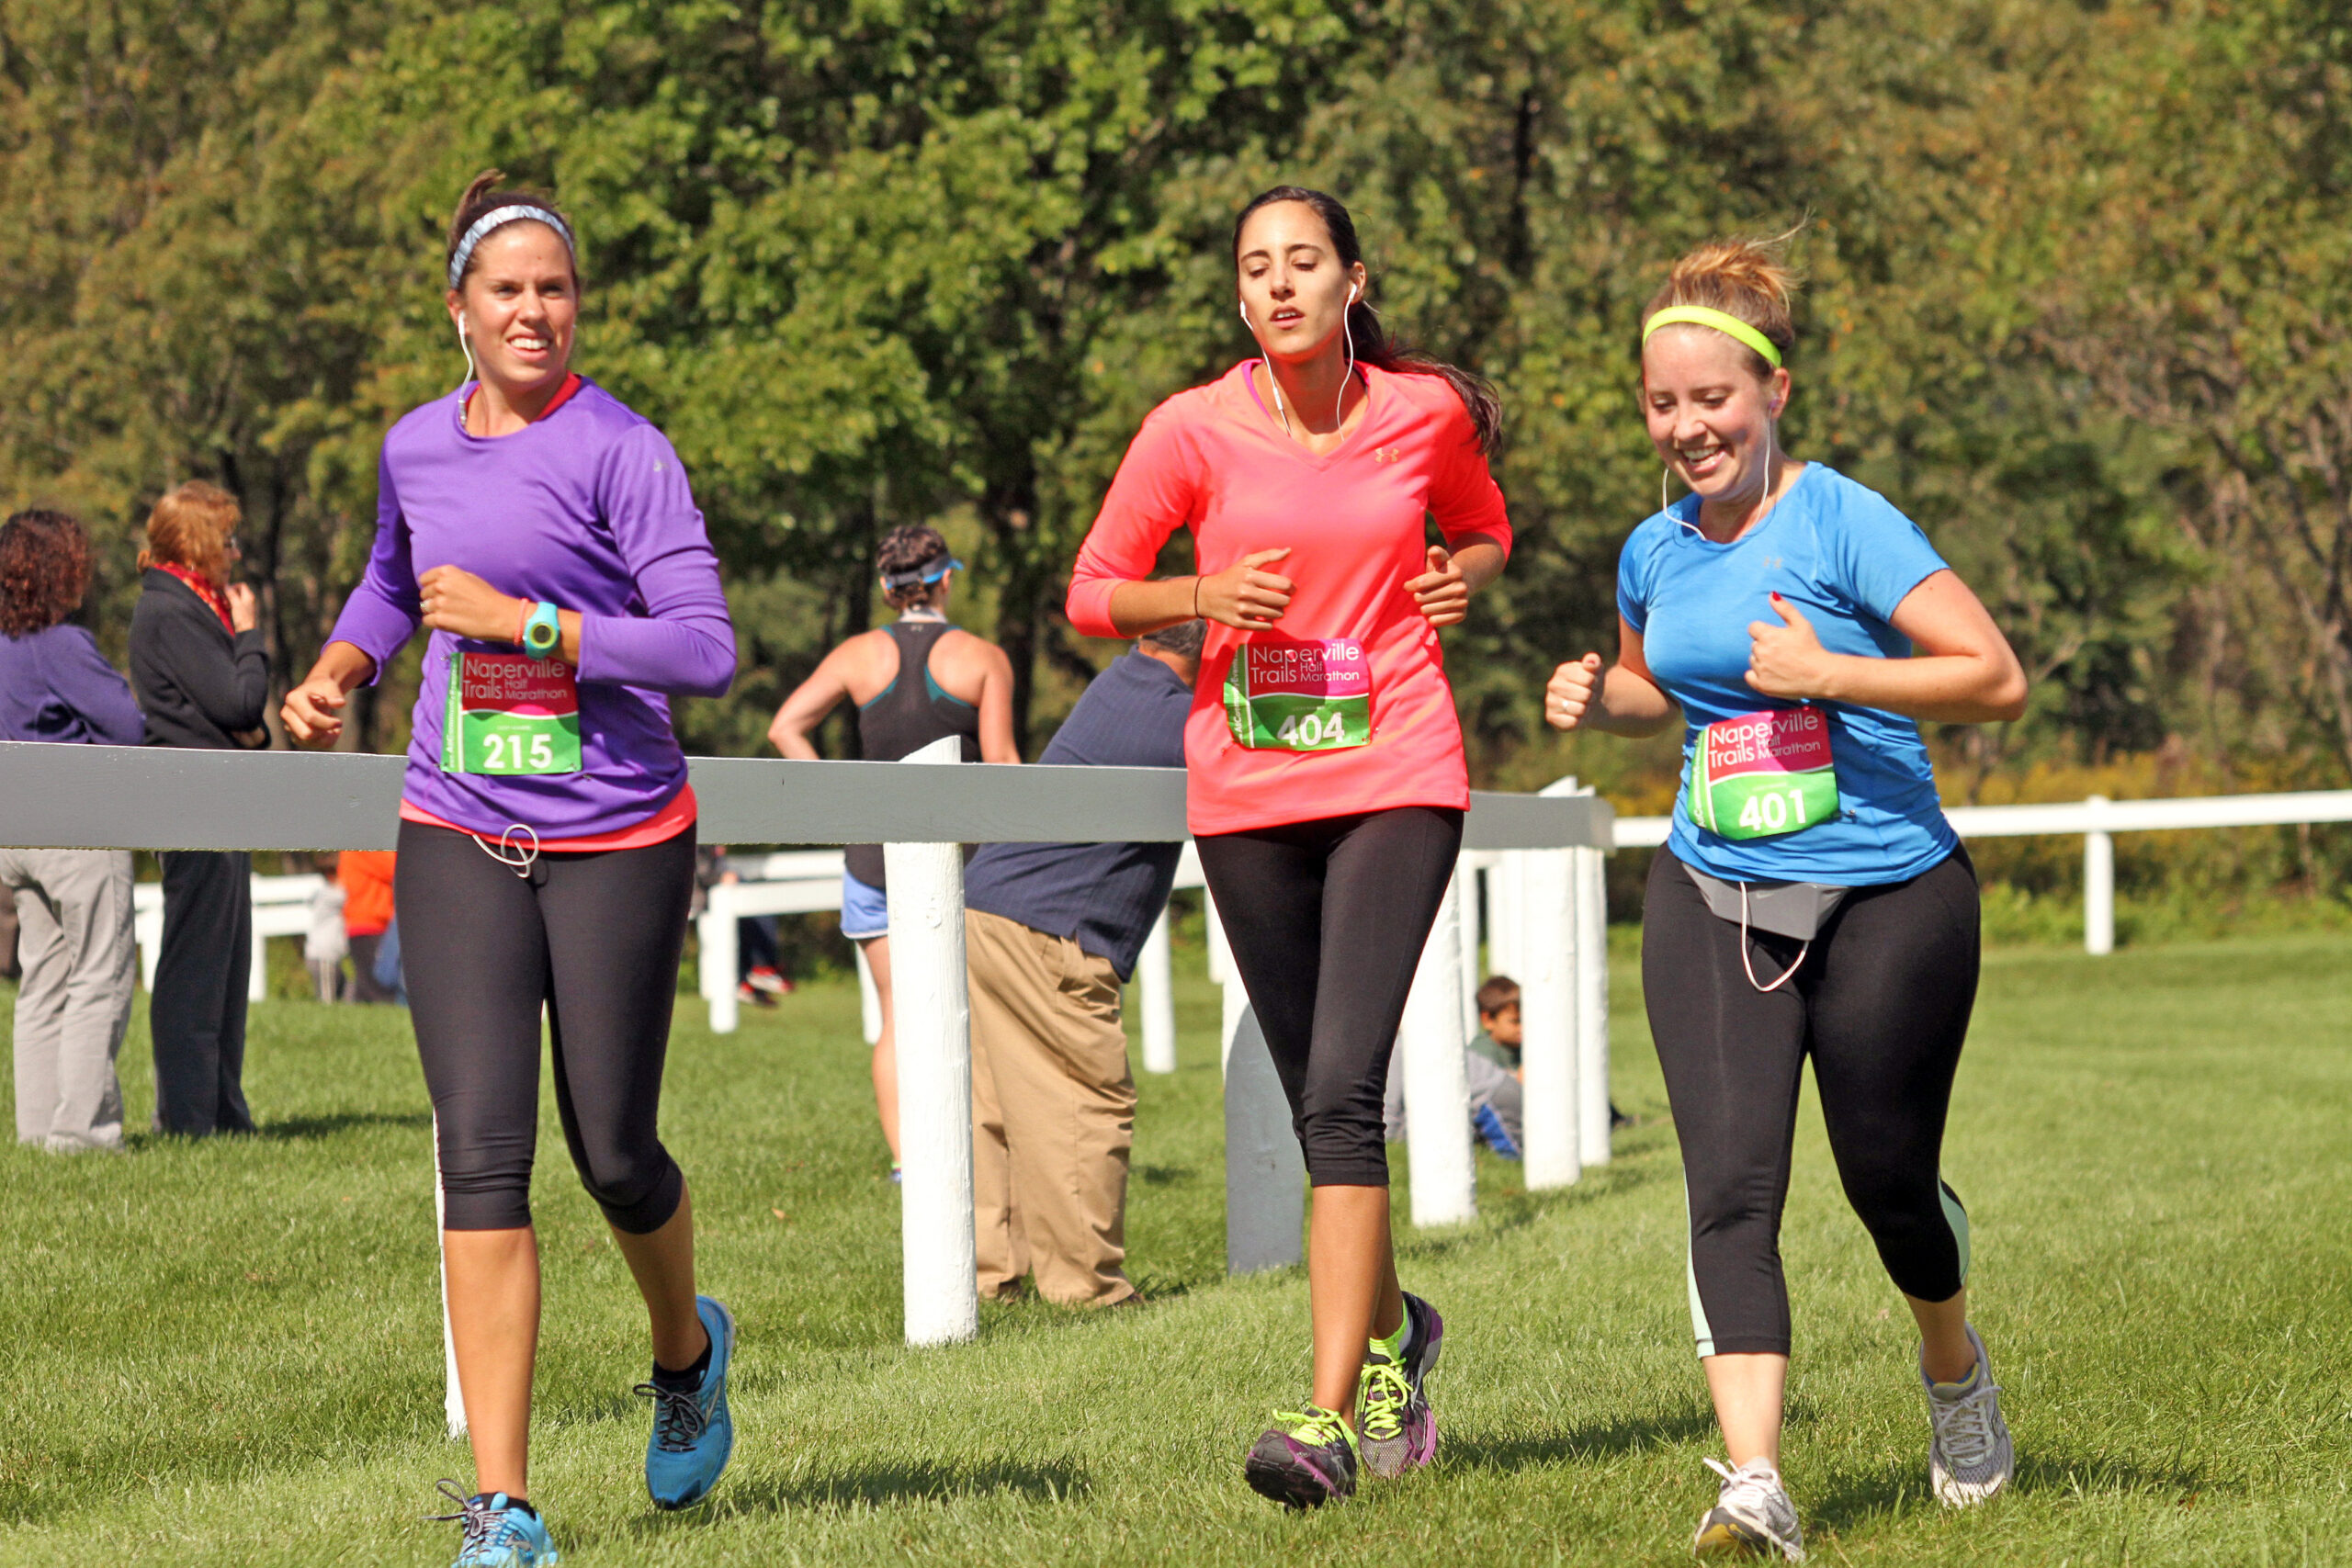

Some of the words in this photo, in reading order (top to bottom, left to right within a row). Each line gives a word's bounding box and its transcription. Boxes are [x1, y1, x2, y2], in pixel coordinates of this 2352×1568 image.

[1253, 643, 1360, 668] Naperville
[466, 658, 565, 685] Naperville
[1250, 665, 1296, 683] Trails
[1300, 661, 1323, 673] Half
[1300, 671, 1360, 682] Marathon
[463, 679, 503, 699] Trails
[505, 678, 528, 689] Half
[505, 689, 567, 700] Marathon
[1277, 712, 1345, 746] 404
[1711, 713, 1818, 748] Naperville
[483, 733, 552, 769] 215
[1756, 734, 1781, 749] Half
[1758, 741, 1820, 760] Marathon
[1709, 745, 1755, 768] Trails
[1739, 789, 1806, 831] 401
